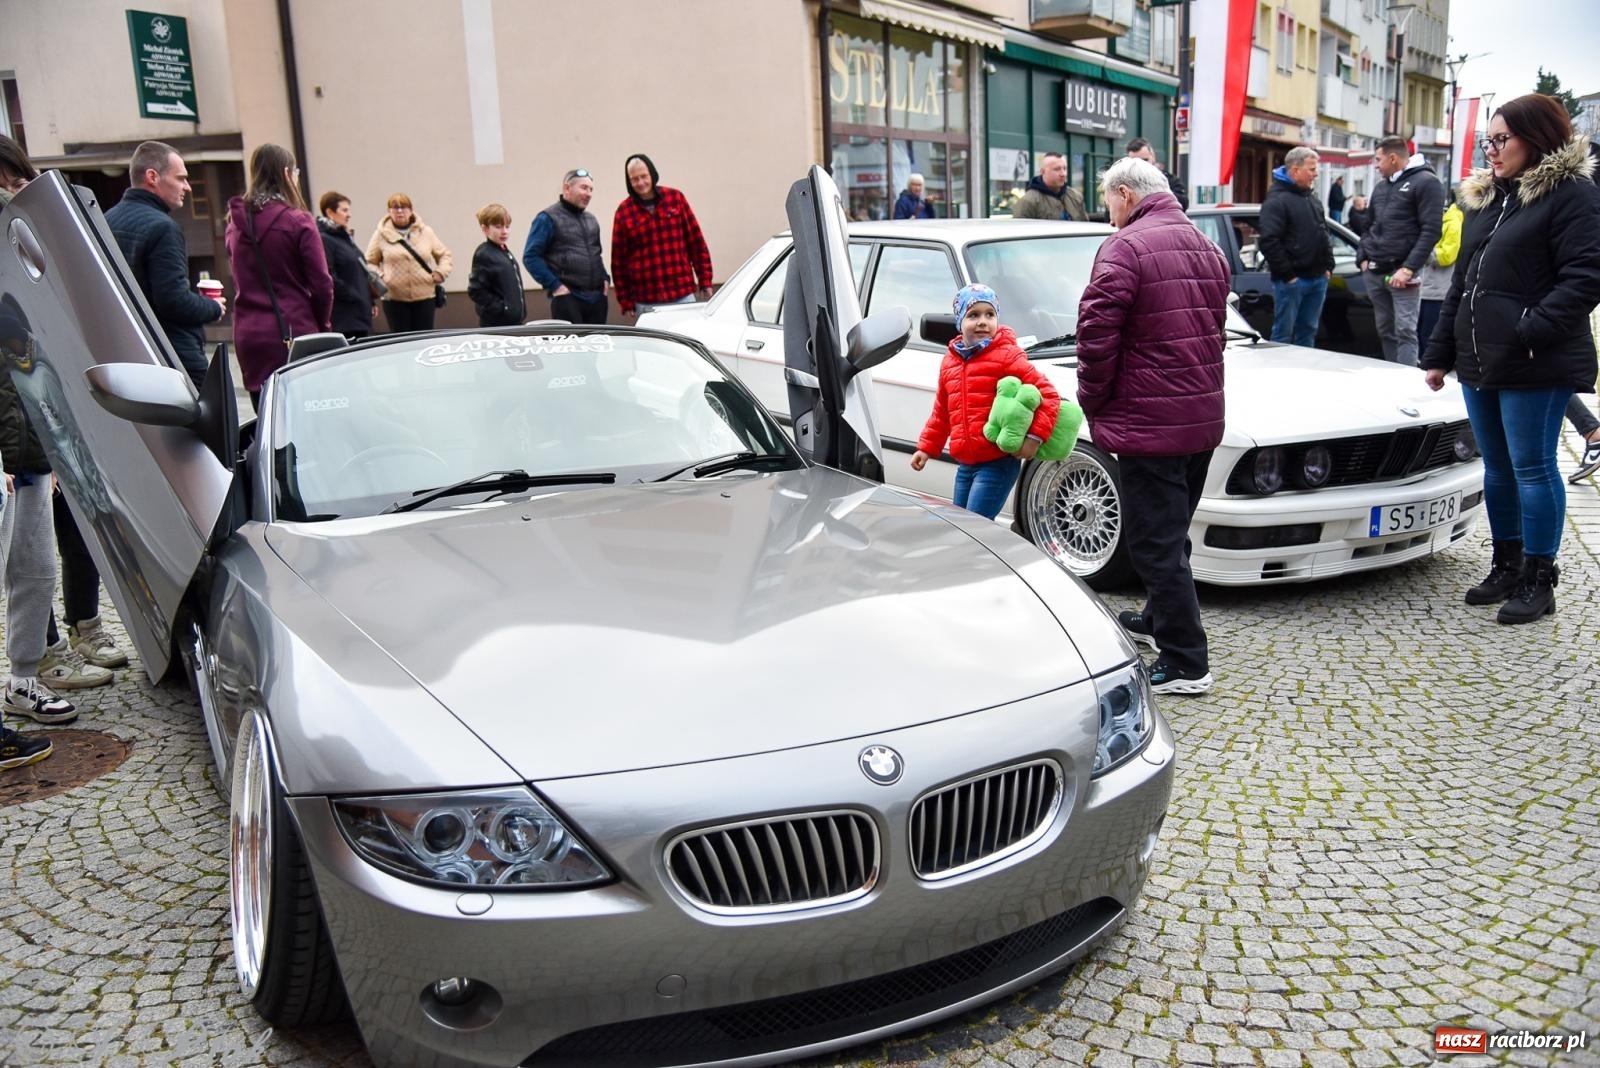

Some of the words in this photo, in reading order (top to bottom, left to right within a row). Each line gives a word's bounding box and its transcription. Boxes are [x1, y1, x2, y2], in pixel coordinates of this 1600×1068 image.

[828, 29, 941, 116] STELLA
[1065, 83, 1127, 120] JUBILER
[303, 397, 350, 411] sparco
[1371, 524, 1378, 533] PL
[1389, 505, 1415, 531] S5
[1428, 496, 1455, 526] E28
